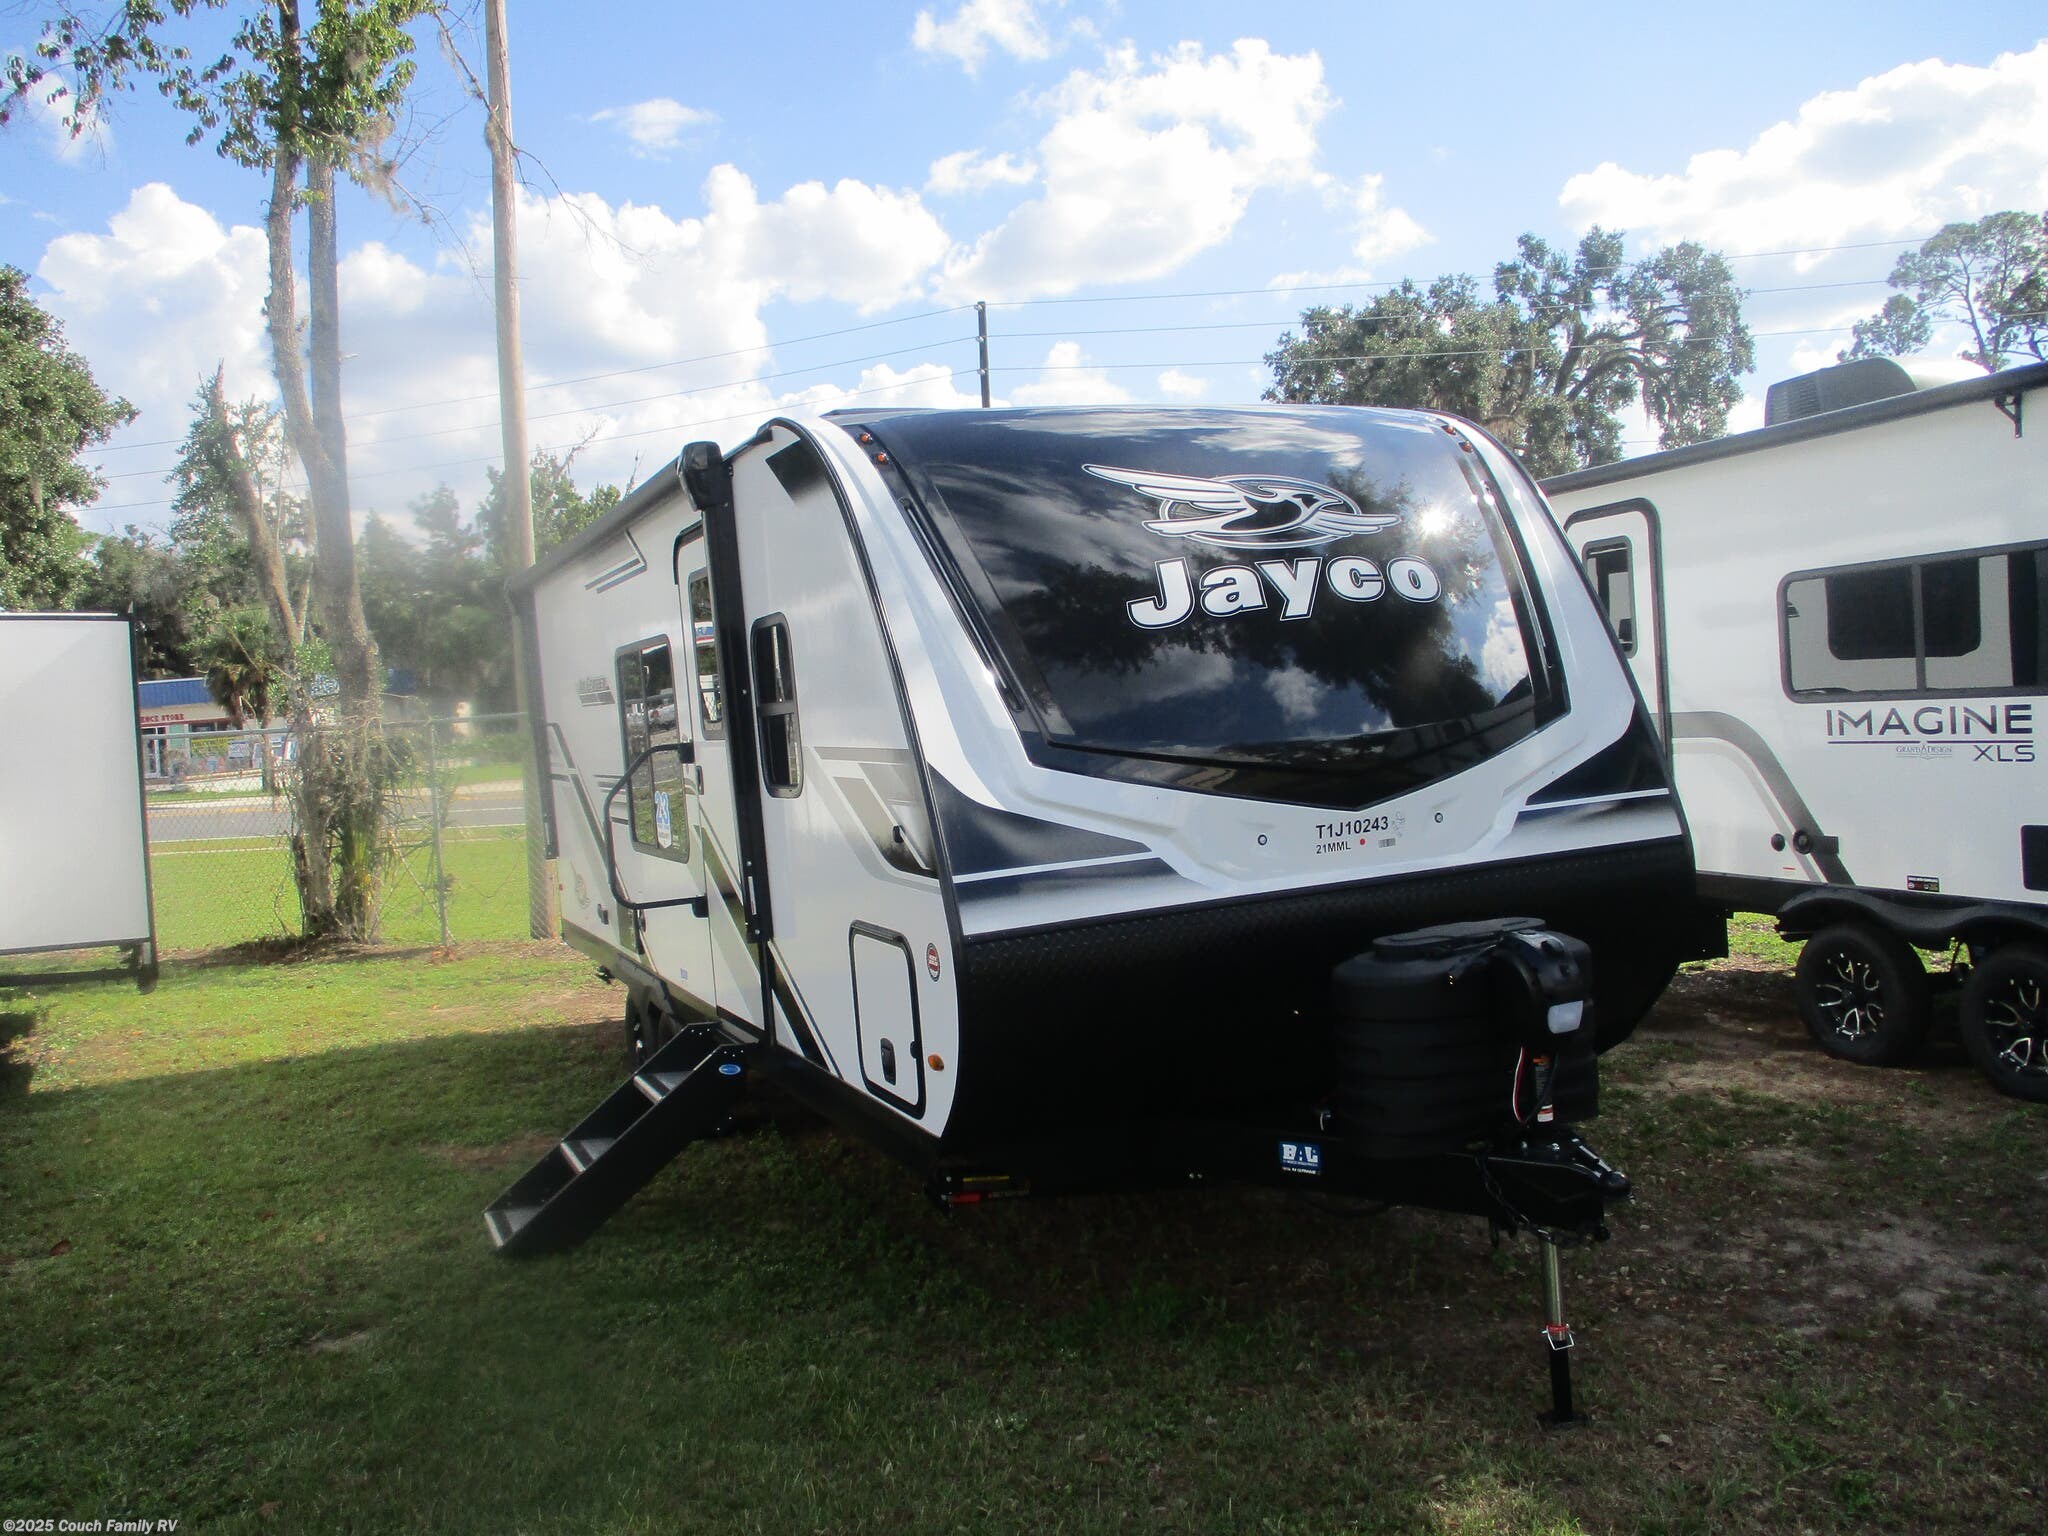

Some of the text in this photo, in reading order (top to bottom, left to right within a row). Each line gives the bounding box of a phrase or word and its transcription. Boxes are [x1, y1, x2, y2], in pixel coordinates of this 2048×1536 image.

[1126, 555, 1442, 629] Jayco
[1826, 704, 2033, 736] IMAGINE
[1973, 744, 2036, 762] XLS
[1316, 816, 1389, 839] T1J10243
[1316, 841, 1351, 854] 21MML
